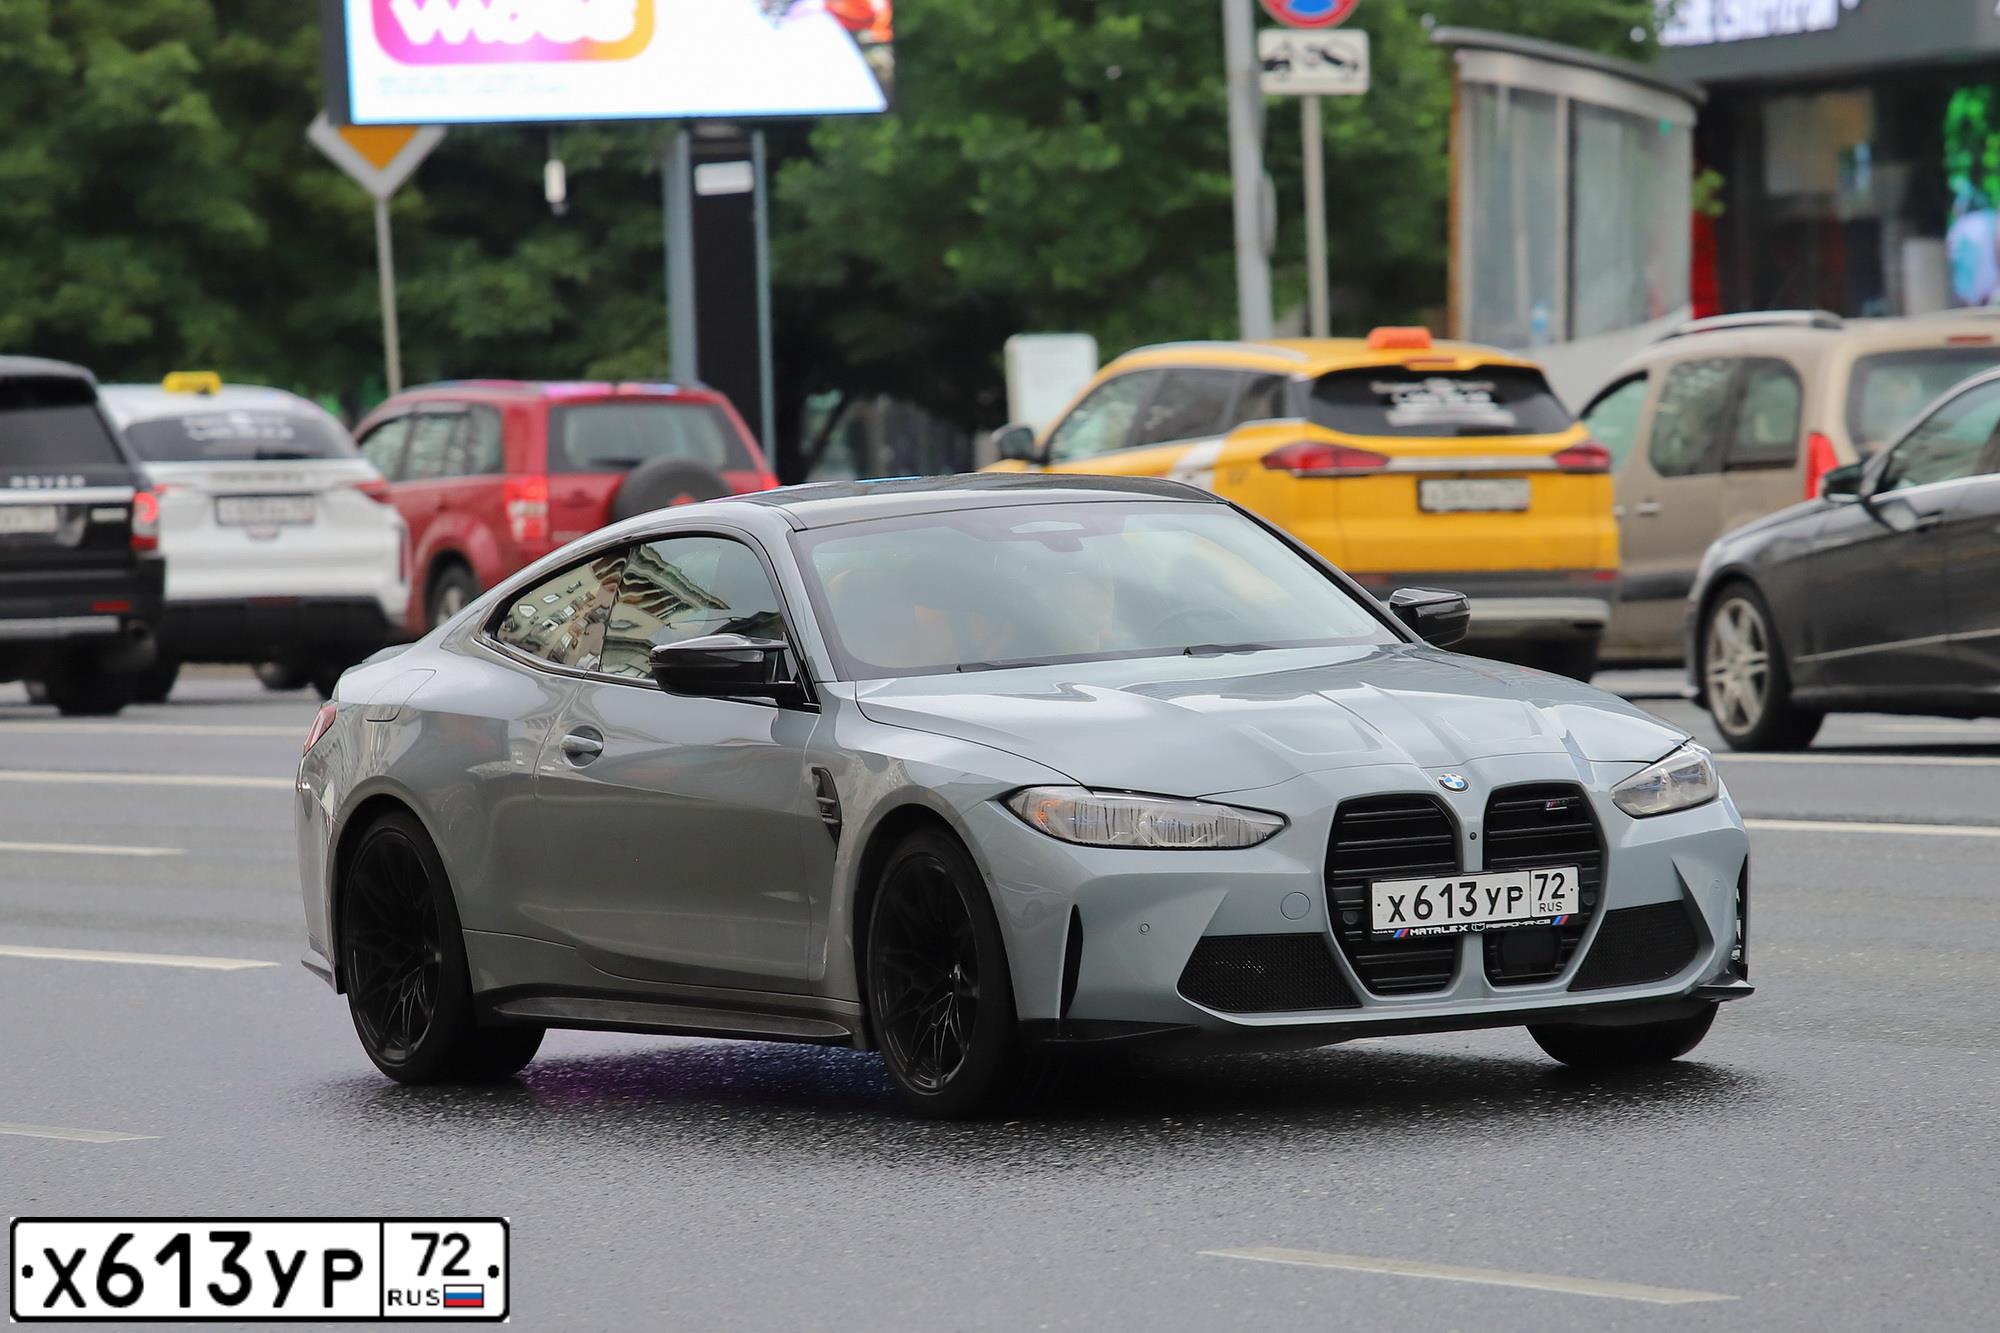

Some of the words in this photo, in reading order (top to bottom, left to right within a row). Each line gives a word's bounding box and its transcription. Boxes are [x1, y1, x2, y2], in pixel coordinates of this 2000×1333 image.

[1387, 881, 1524, 923] Х613УР
[1534, 872, 1566, 901] 72
[1539, 901, 1563, 913] RUS
[1409, 924, 1469, 936] MATALEX
